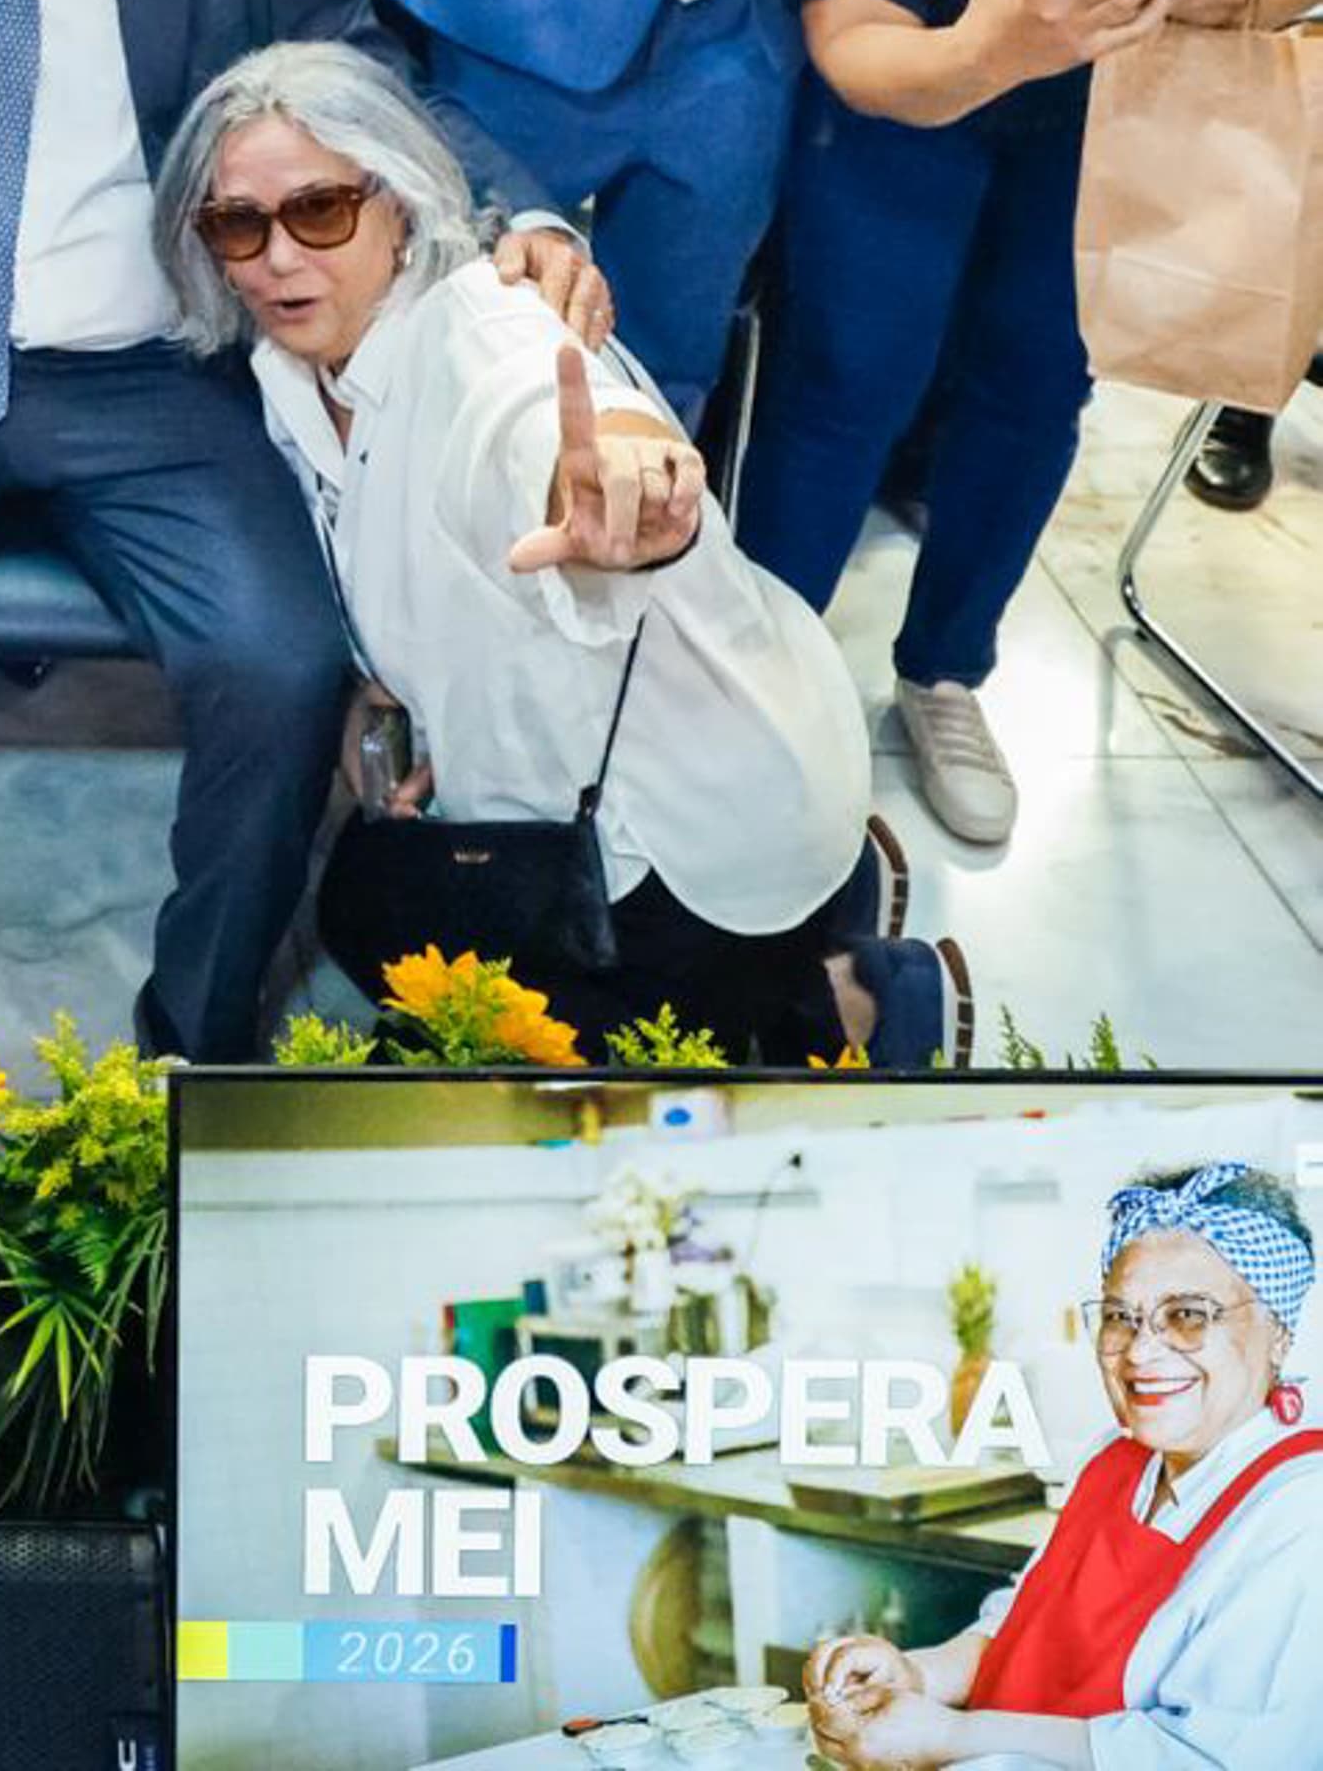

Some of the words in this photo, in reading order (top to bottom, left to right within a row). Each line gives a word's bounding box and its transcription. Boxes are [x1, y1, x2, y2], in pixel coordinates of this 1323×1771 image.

[304, 1354, 1054, 1468] PROSPERA
[303, 1488, 542, 1597] MEI
[336, 1630, 477, 1676] 2026
